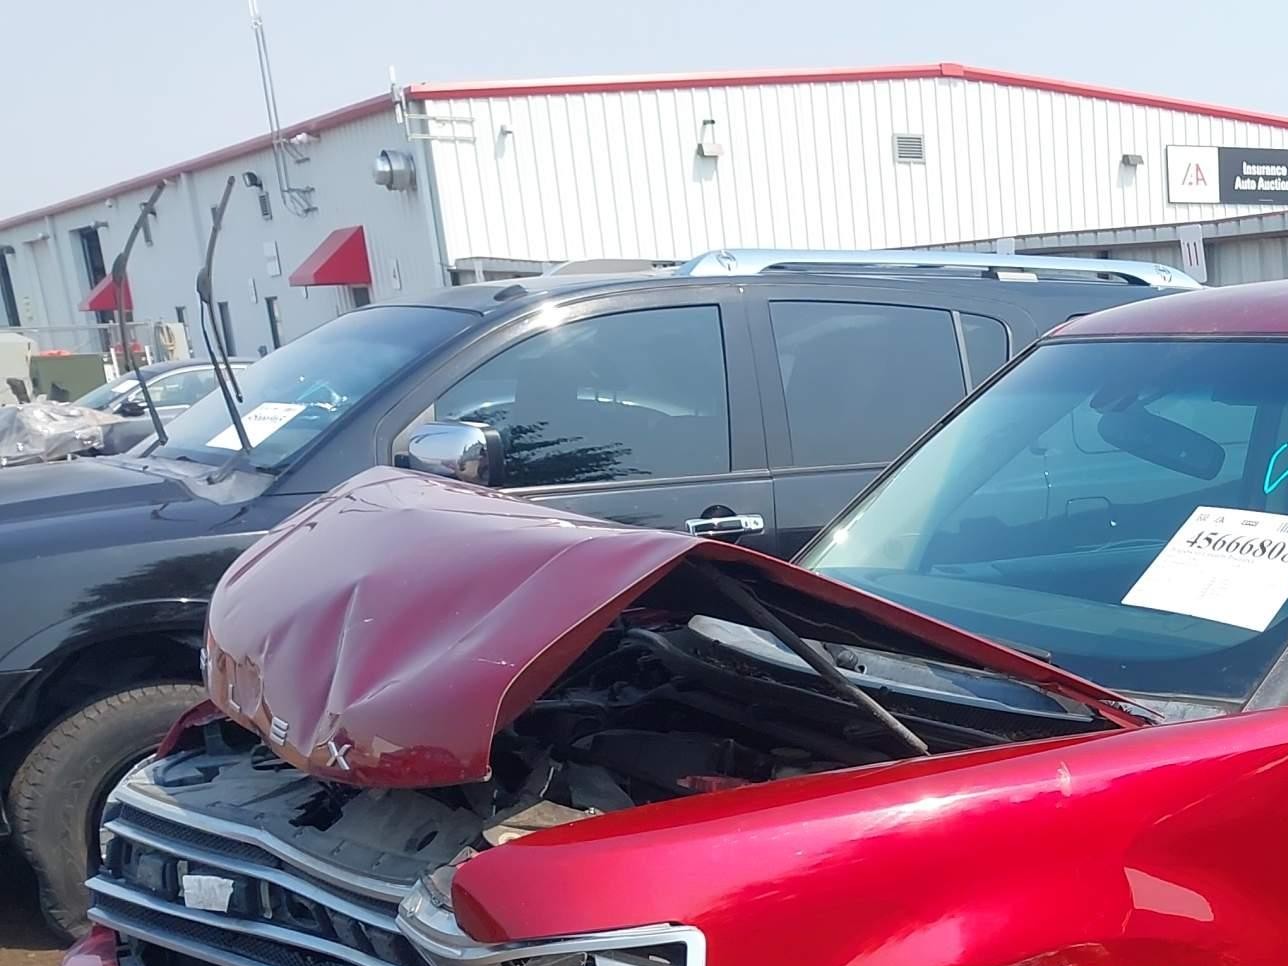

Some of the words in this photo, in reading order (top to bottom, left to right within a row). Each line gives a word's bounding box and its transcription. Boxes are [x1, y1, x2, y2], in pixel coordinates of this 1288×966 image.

[1242, 161, 1288, 176] Insurance
[1234, 177, 1256, 190] Auto
[1186, 242, 1199, 266] 11
